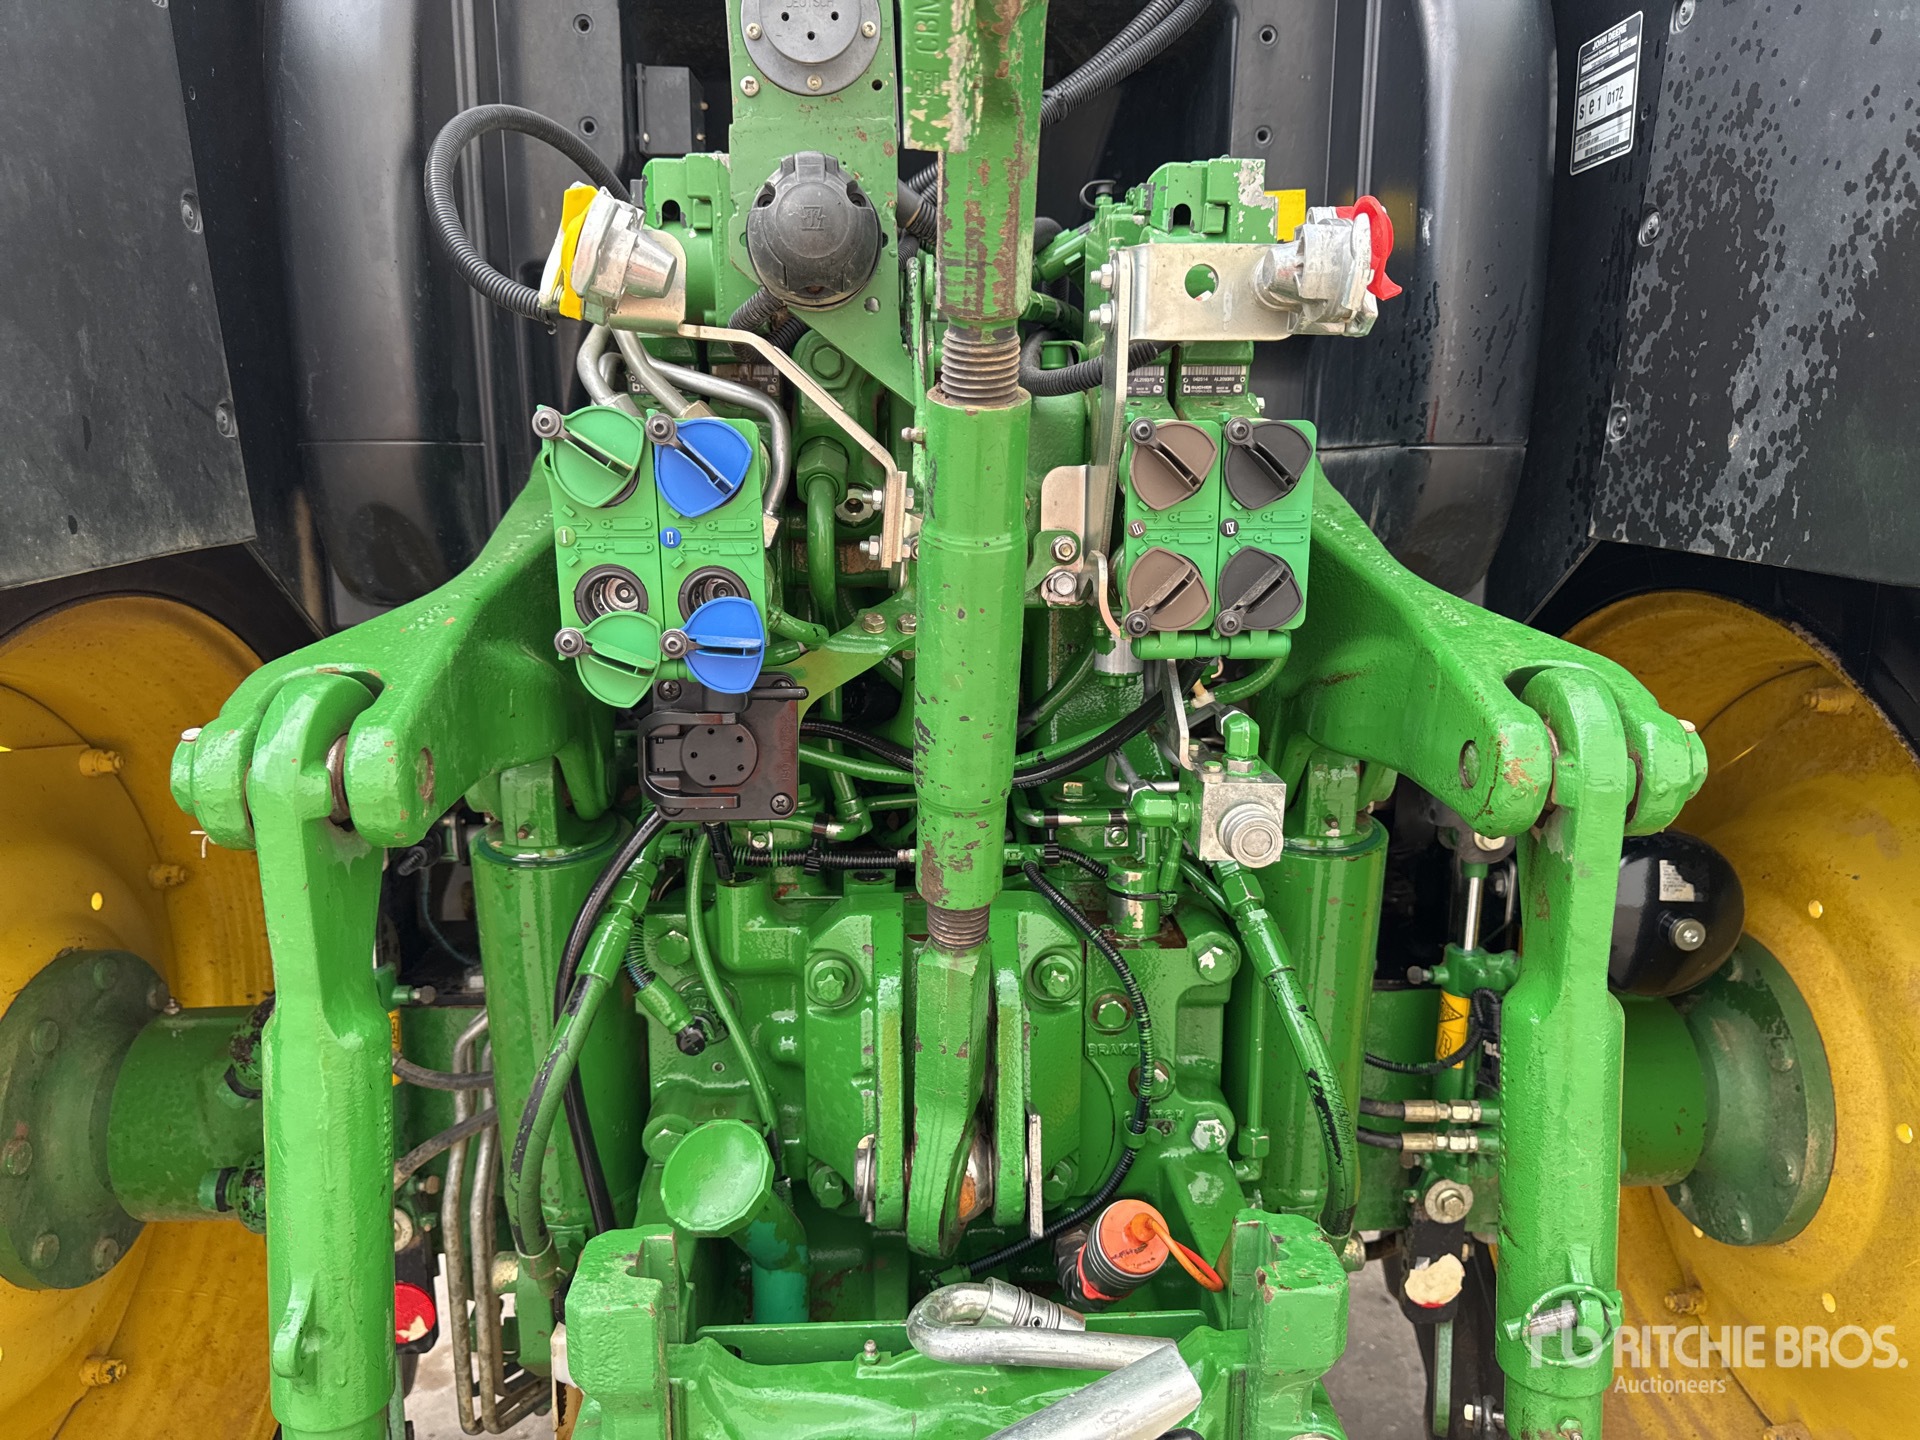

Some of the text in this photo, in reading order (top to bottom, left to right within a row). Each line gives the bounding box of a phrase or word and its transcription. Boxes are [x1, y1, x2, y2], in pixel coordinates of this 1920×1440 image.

[1592, 35, 1607, 50] JOHN
[1607, 23, 1628, 42] DEERE
[1607, 86, 1624, 106] 0172
